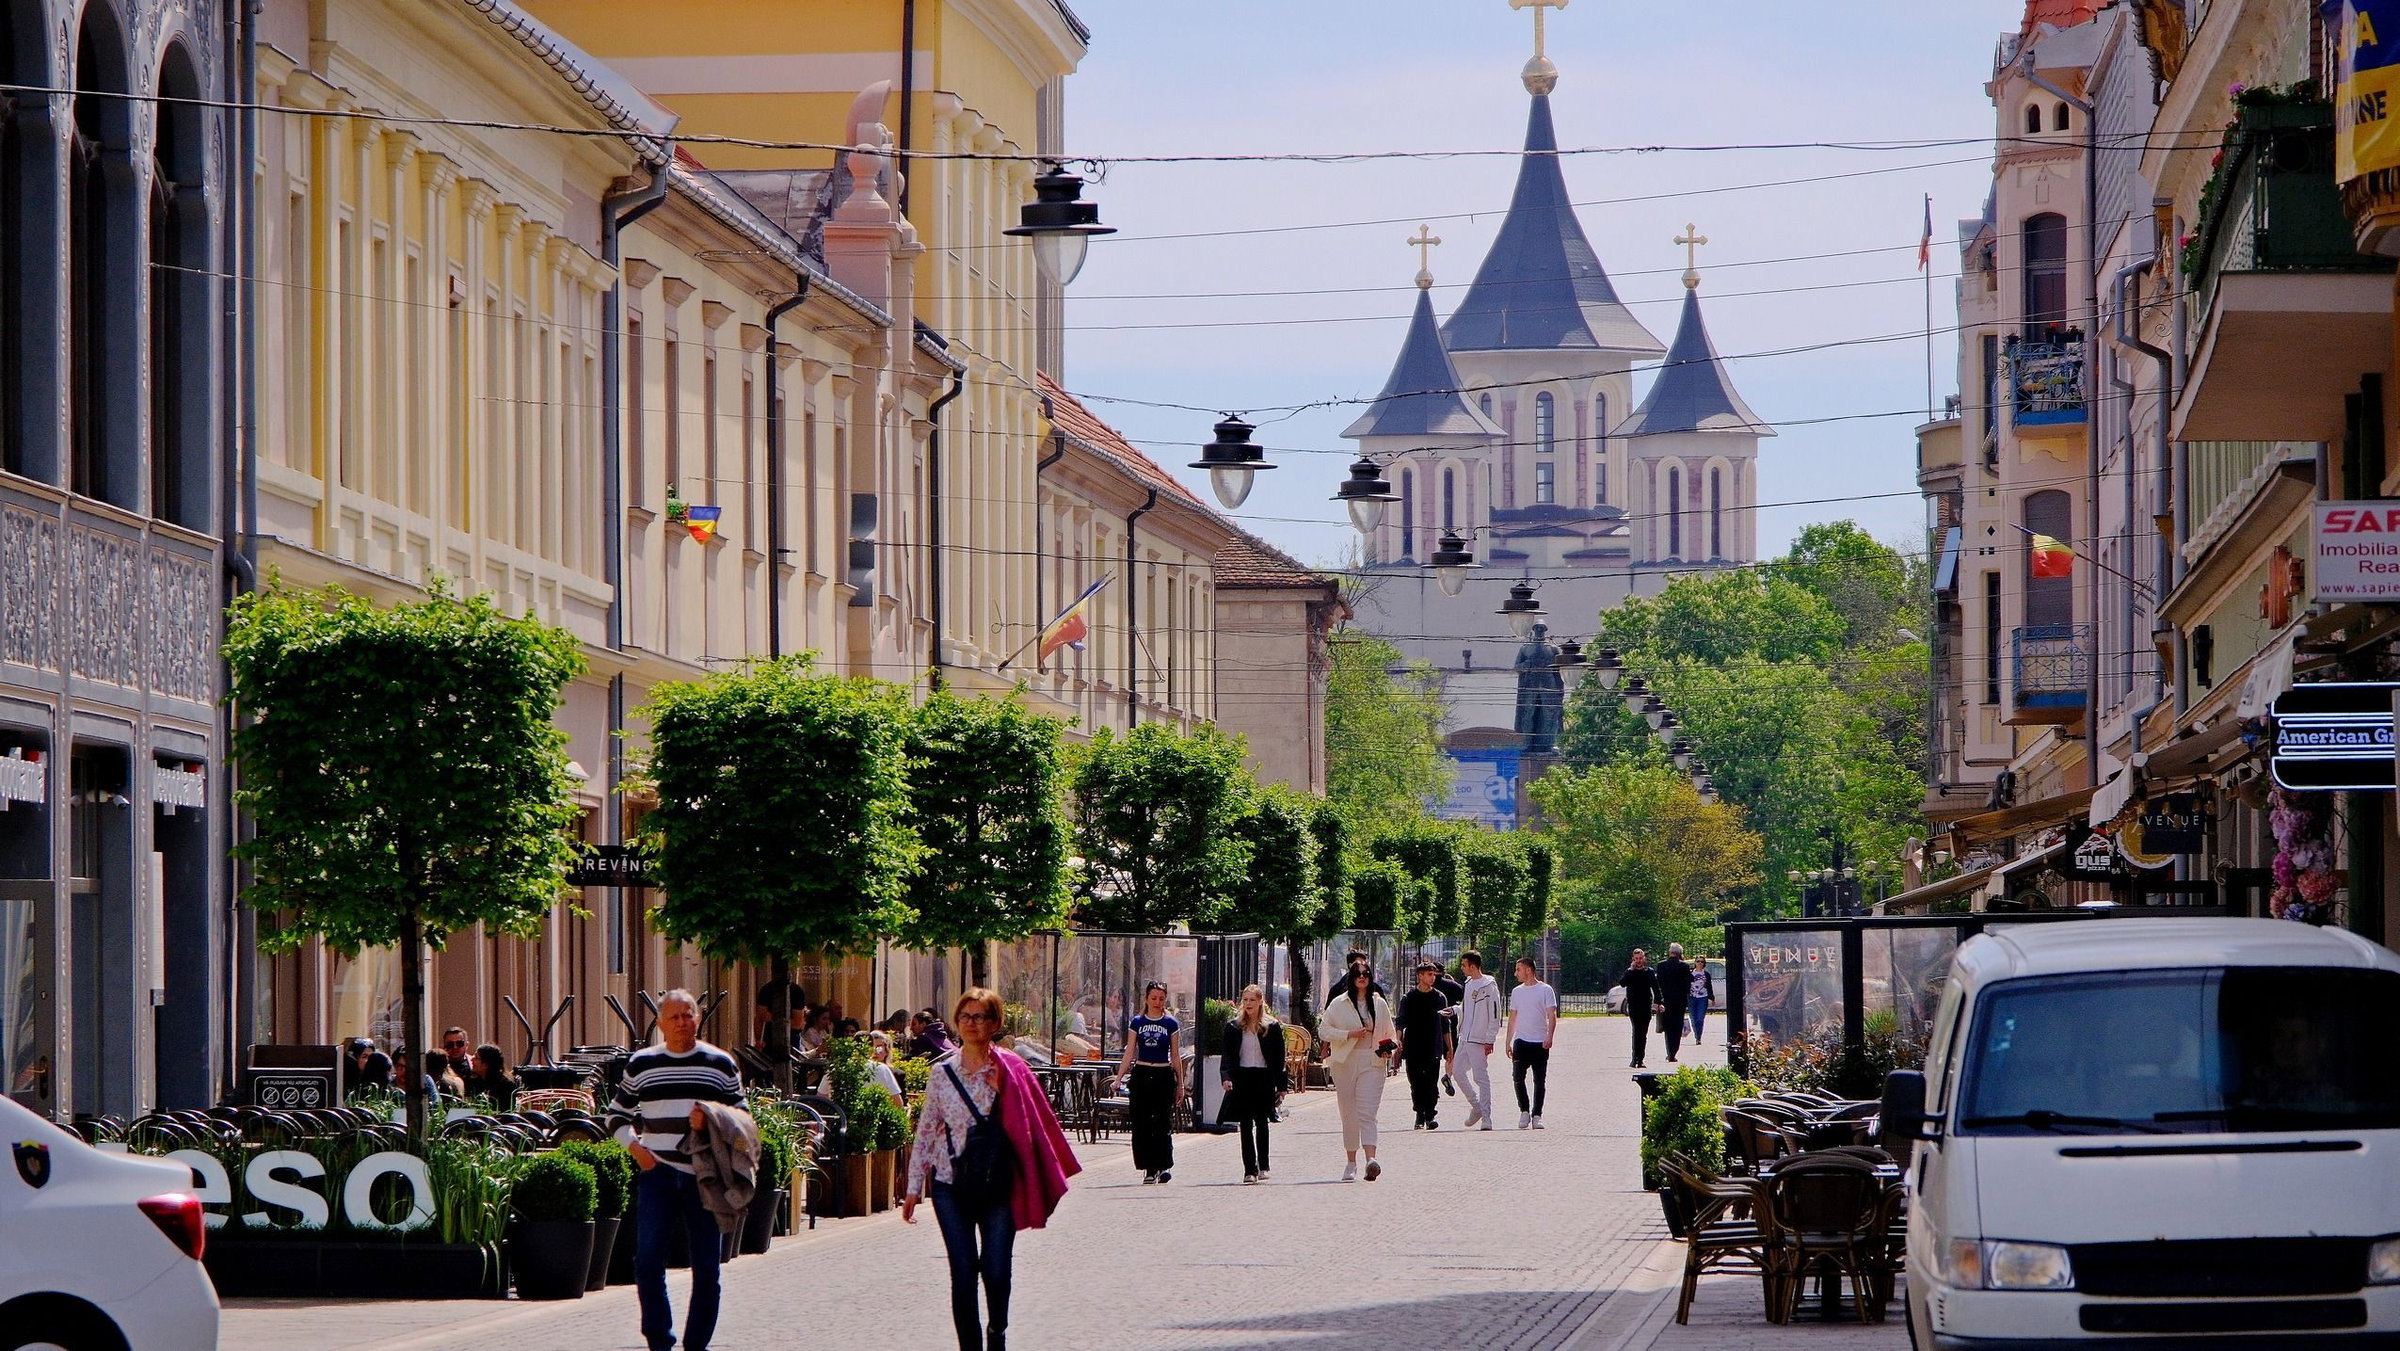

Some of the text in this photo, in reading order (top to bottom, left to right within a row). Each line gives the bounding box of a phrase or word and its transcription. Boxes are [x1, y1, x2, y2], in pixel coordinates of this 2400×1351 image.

[2276, 729, 2371, 744] American
[2144, 815, 2200, 826] VENUE
[2075, 855, 2111, 869] gus
[1138, 1024, 1168, 1036] LONDON
